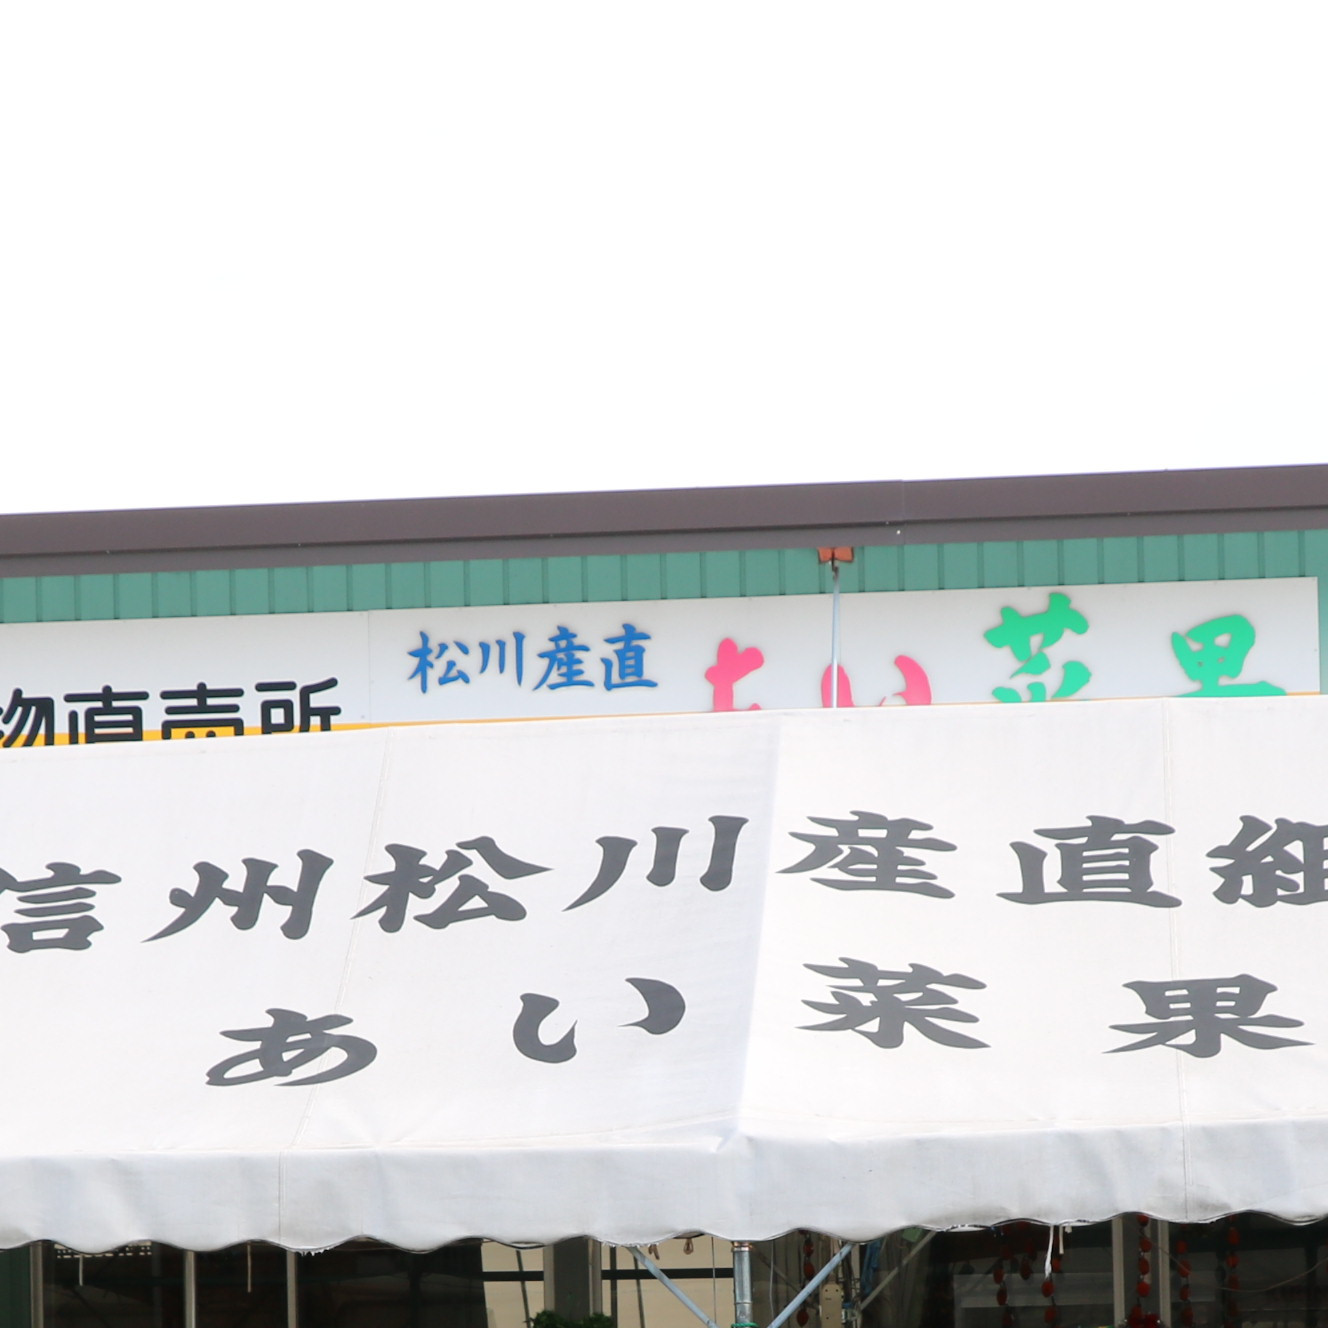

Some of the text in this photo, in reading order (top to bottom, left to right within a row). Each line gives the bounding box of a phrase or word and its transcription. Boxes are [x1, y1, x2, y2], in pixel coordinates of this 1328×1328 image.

[406, 622, 659, 694] 松川産直
[205, 957, 1314, 1087] あい菜果
